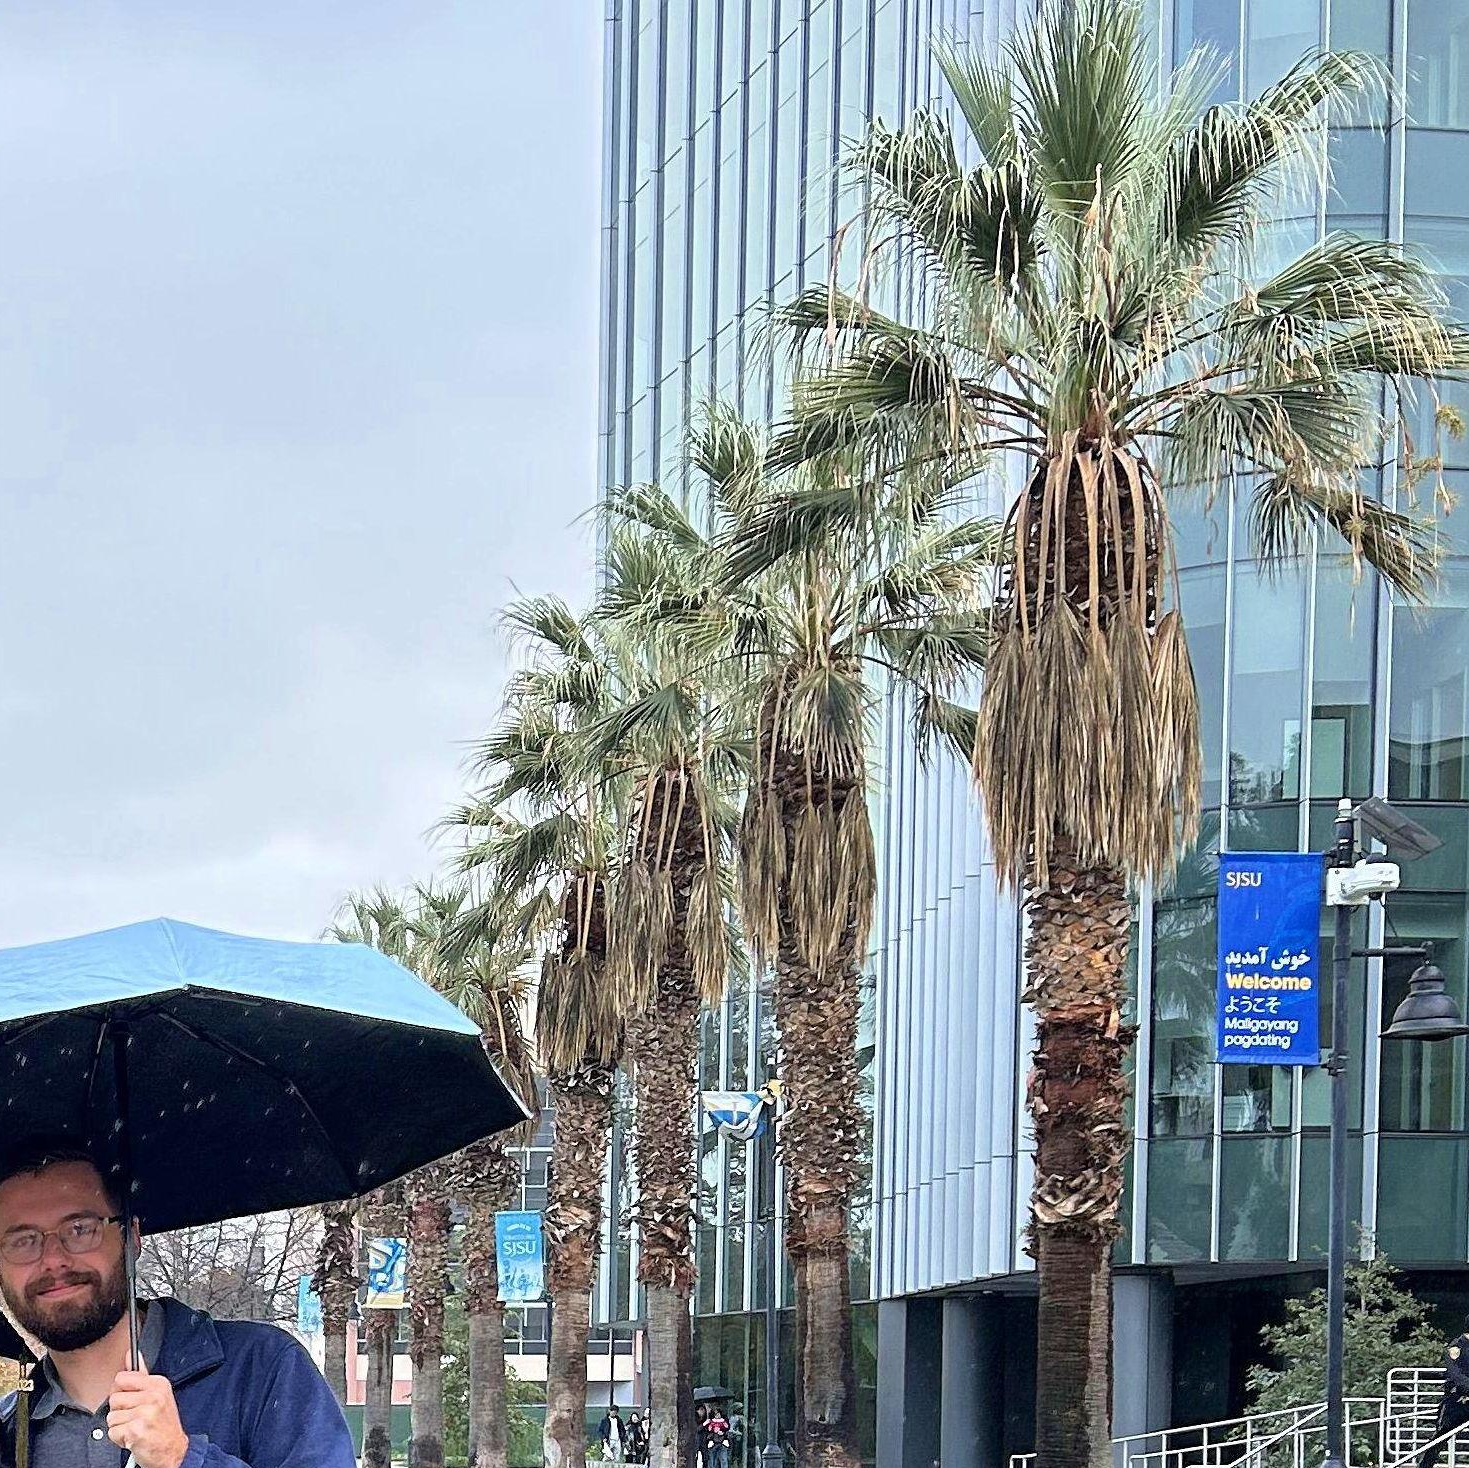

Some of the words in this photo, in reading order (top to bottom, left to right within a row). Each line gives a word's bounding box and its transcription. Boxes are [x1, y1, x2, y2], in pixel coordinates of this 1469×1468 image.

[1225, 872, 1263, 889] SJSU
[1224, 946, 1270, 969] آمدید
[1270, 949, 1311, 971] خوش
[1224, 972, 1312, 990] Welcome
[1224, 995, 1282, 1014] ようこそ
[1224, 1016, 1299, 1034] Maligayang
[1223, 1033, 1291, 1050] pagdating
[502, 1240, 537, 1258] SJSU
